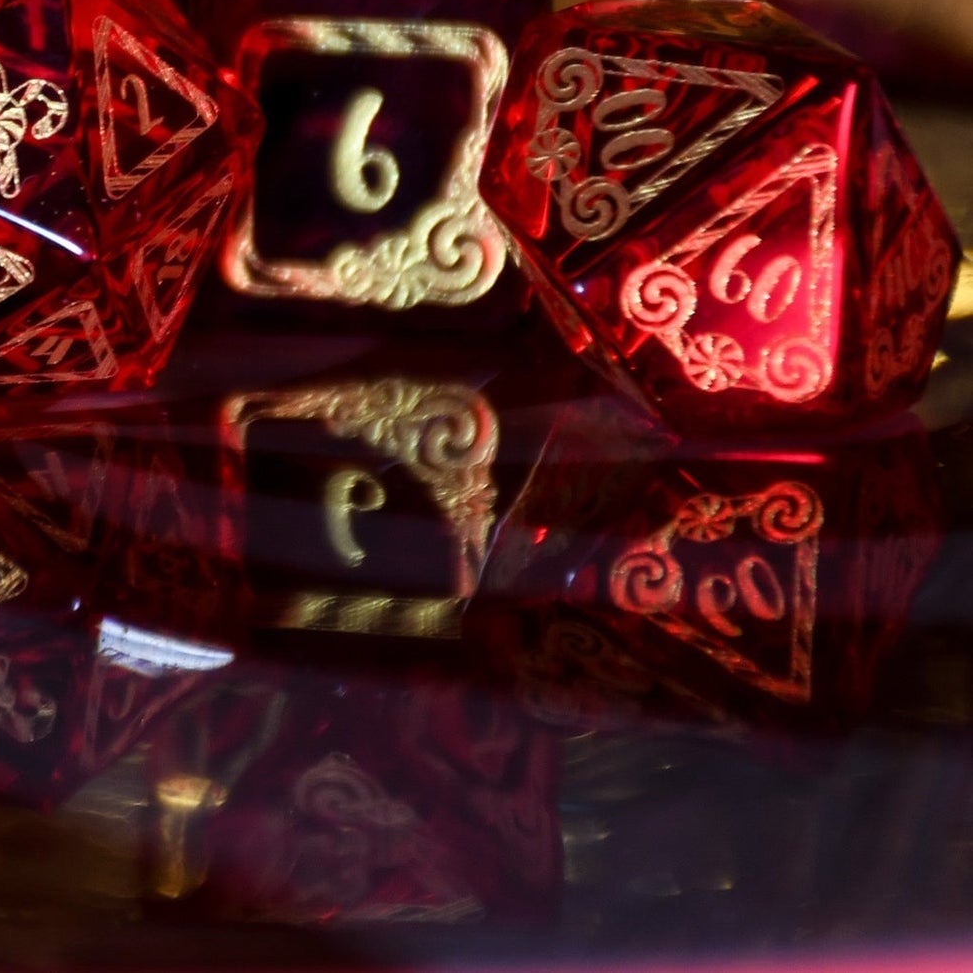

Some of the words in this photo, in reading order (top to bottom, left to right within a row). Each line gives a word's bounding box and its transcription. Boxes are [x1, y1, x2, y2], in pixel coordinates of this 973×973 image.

[120, 73, 165, 138] 2
[592, 88, 676, 171] 00
[330, 86, 401, 215] 6
[707, 233, 802, 324] 60
